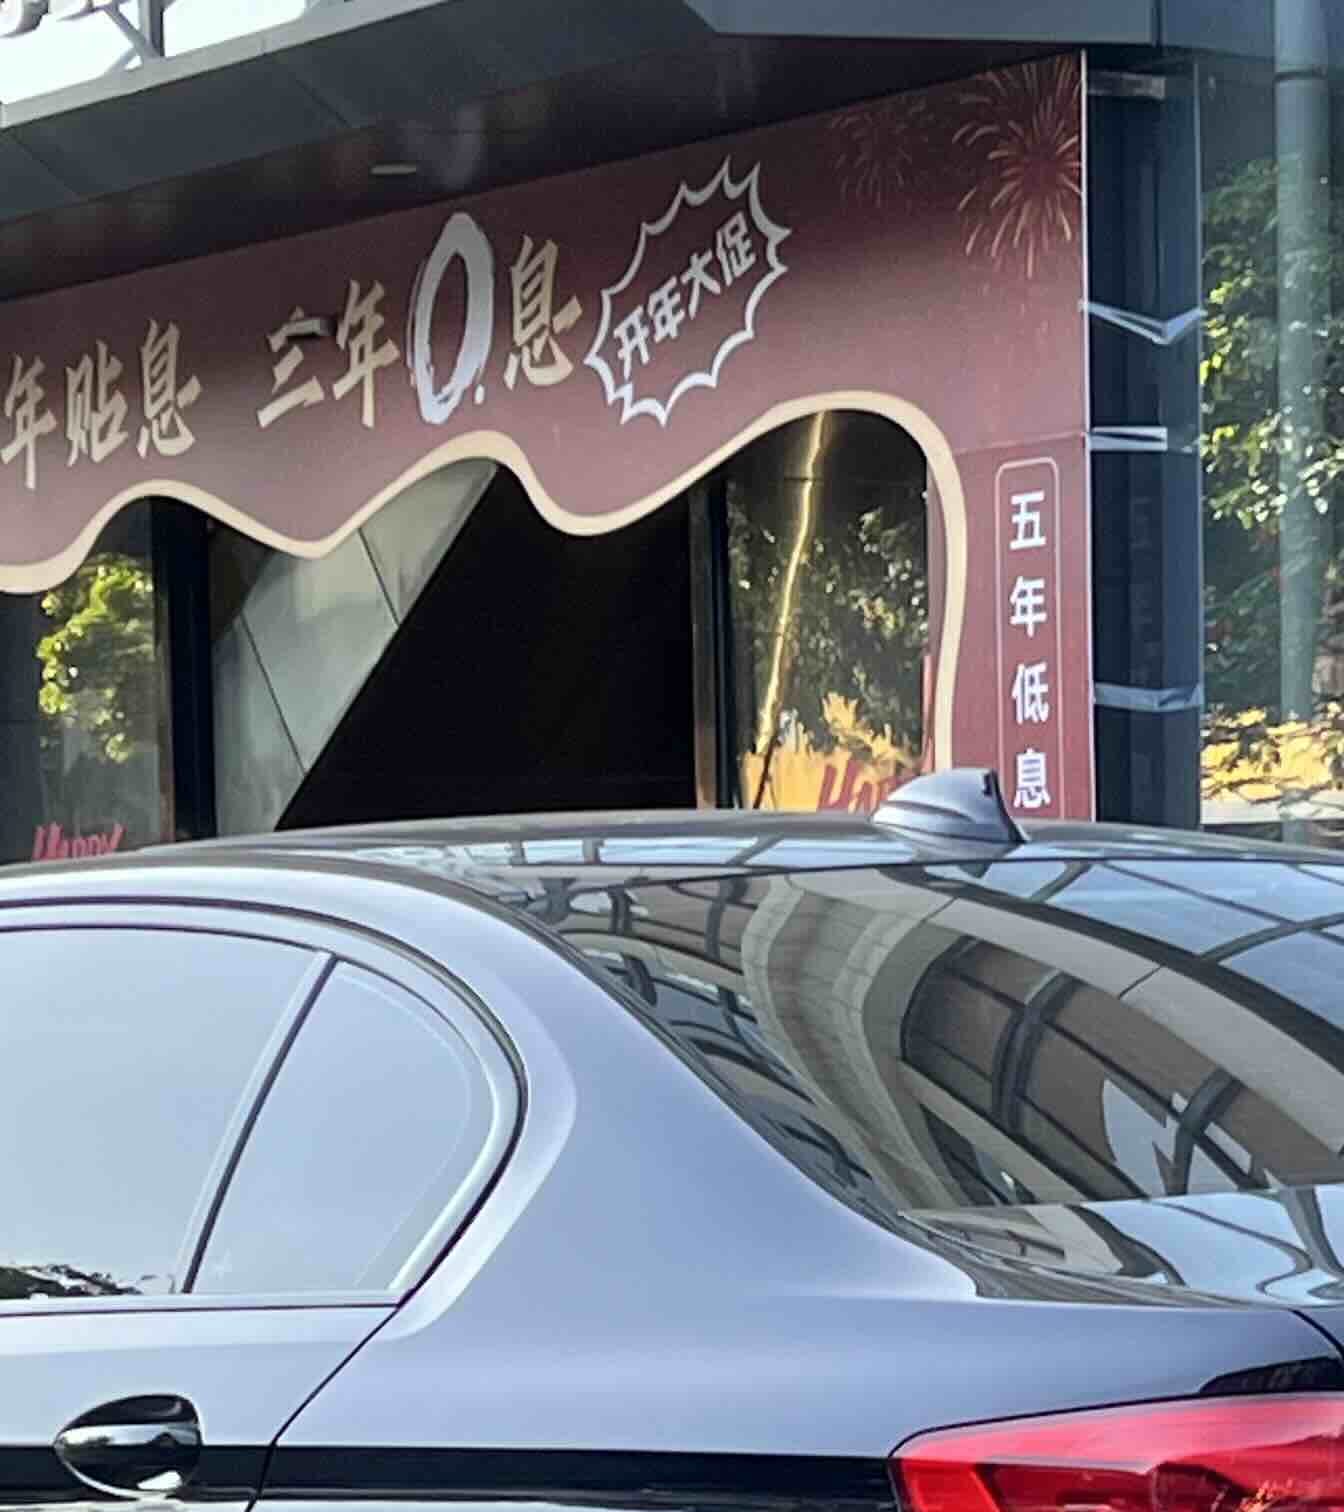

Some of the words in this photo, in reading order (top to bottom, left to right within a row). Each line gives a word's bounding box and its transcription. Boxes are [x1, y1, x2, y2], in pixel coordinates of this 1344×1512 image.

[613, 210, 757, 381] 开年大促
[1009, 489, 1051, 809] 五年低息
